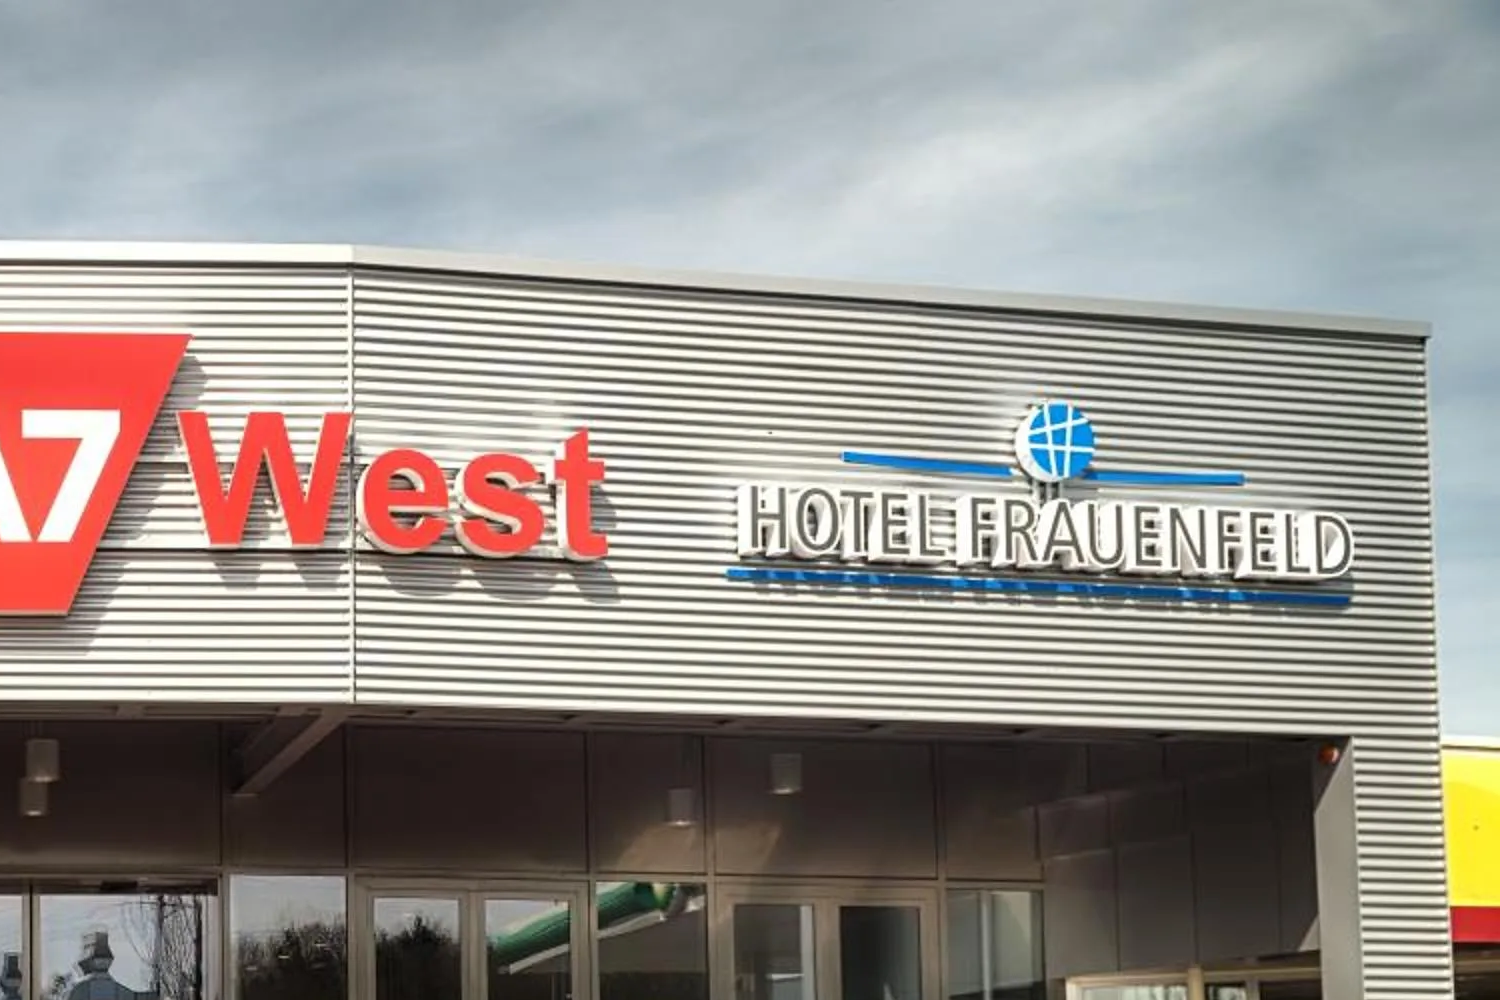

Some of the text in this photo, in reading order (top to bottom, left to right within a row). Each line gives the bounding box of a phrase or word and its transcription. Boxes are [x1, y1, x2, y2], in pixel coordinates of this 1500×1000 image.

[175, 411, 609, 561] West
[742, 484, 1354, 578] HOTEL FRAUENFELD
